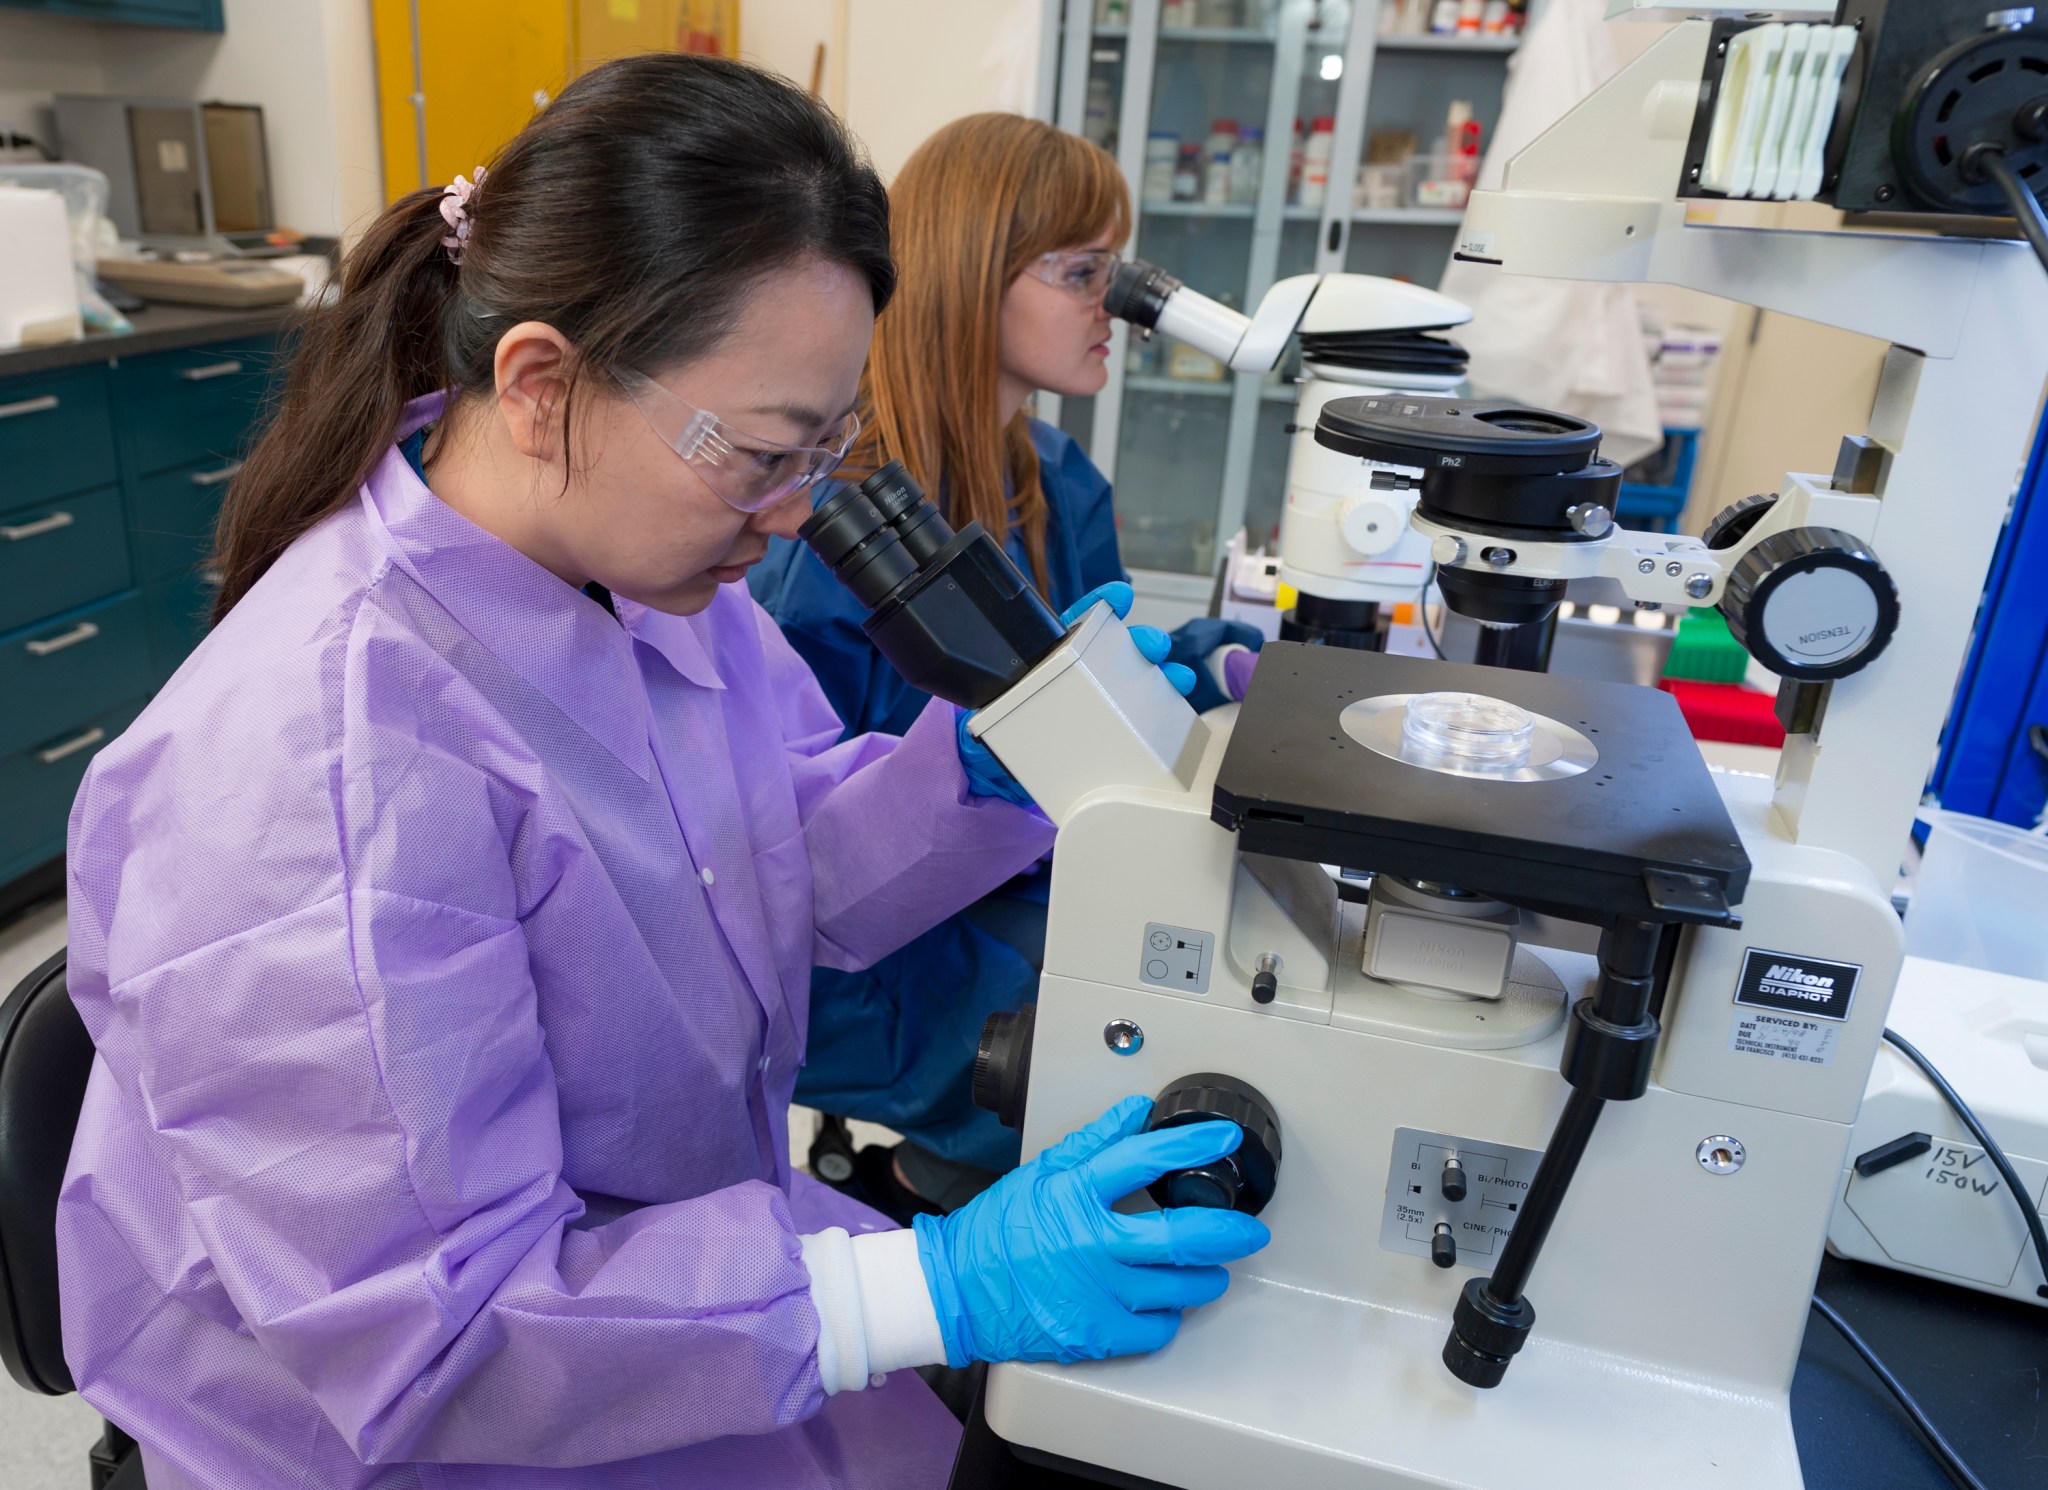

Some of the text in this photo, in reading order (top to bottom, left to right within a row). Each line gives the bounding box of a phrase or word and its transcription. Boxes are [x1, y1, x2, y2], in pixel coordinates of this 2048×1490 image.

[1441, 456, 1462, 467] Ph2
[884, 486, 906, 506] Nikon
[891, 494, 909, 509] JAPAN
[1798, 625, 1852, 644] TENSION
[1764, 964, 1835, 988] Nikon
[1758, 984, 1832, 1003] DIAPHOT
[1740, 1021, 1757, 1031] DATE
[1755, 1015, 1819, 1031] SERVICED BY:
[1737, 1030, 1752, 1039] DUE
[1736, 1038, 1763, 1048] TECHNICAL
[1764, 1043, 1798, 1053] INSTRUMENT
[1746, 1046, 1775, 1056] FRANCISCO
[1932, 1147, 1986, 1169] 15V
[1411, 1162, 1421, 1171] Bi
[1478, 1174, 1529, 1190] Bi/PHOTO
[1926, 1168, 1999, 1196] 150W
[1396, 1204, 1425, 1217] 35mm
[1396, 1213, 1423, 1225] (2.5x)
